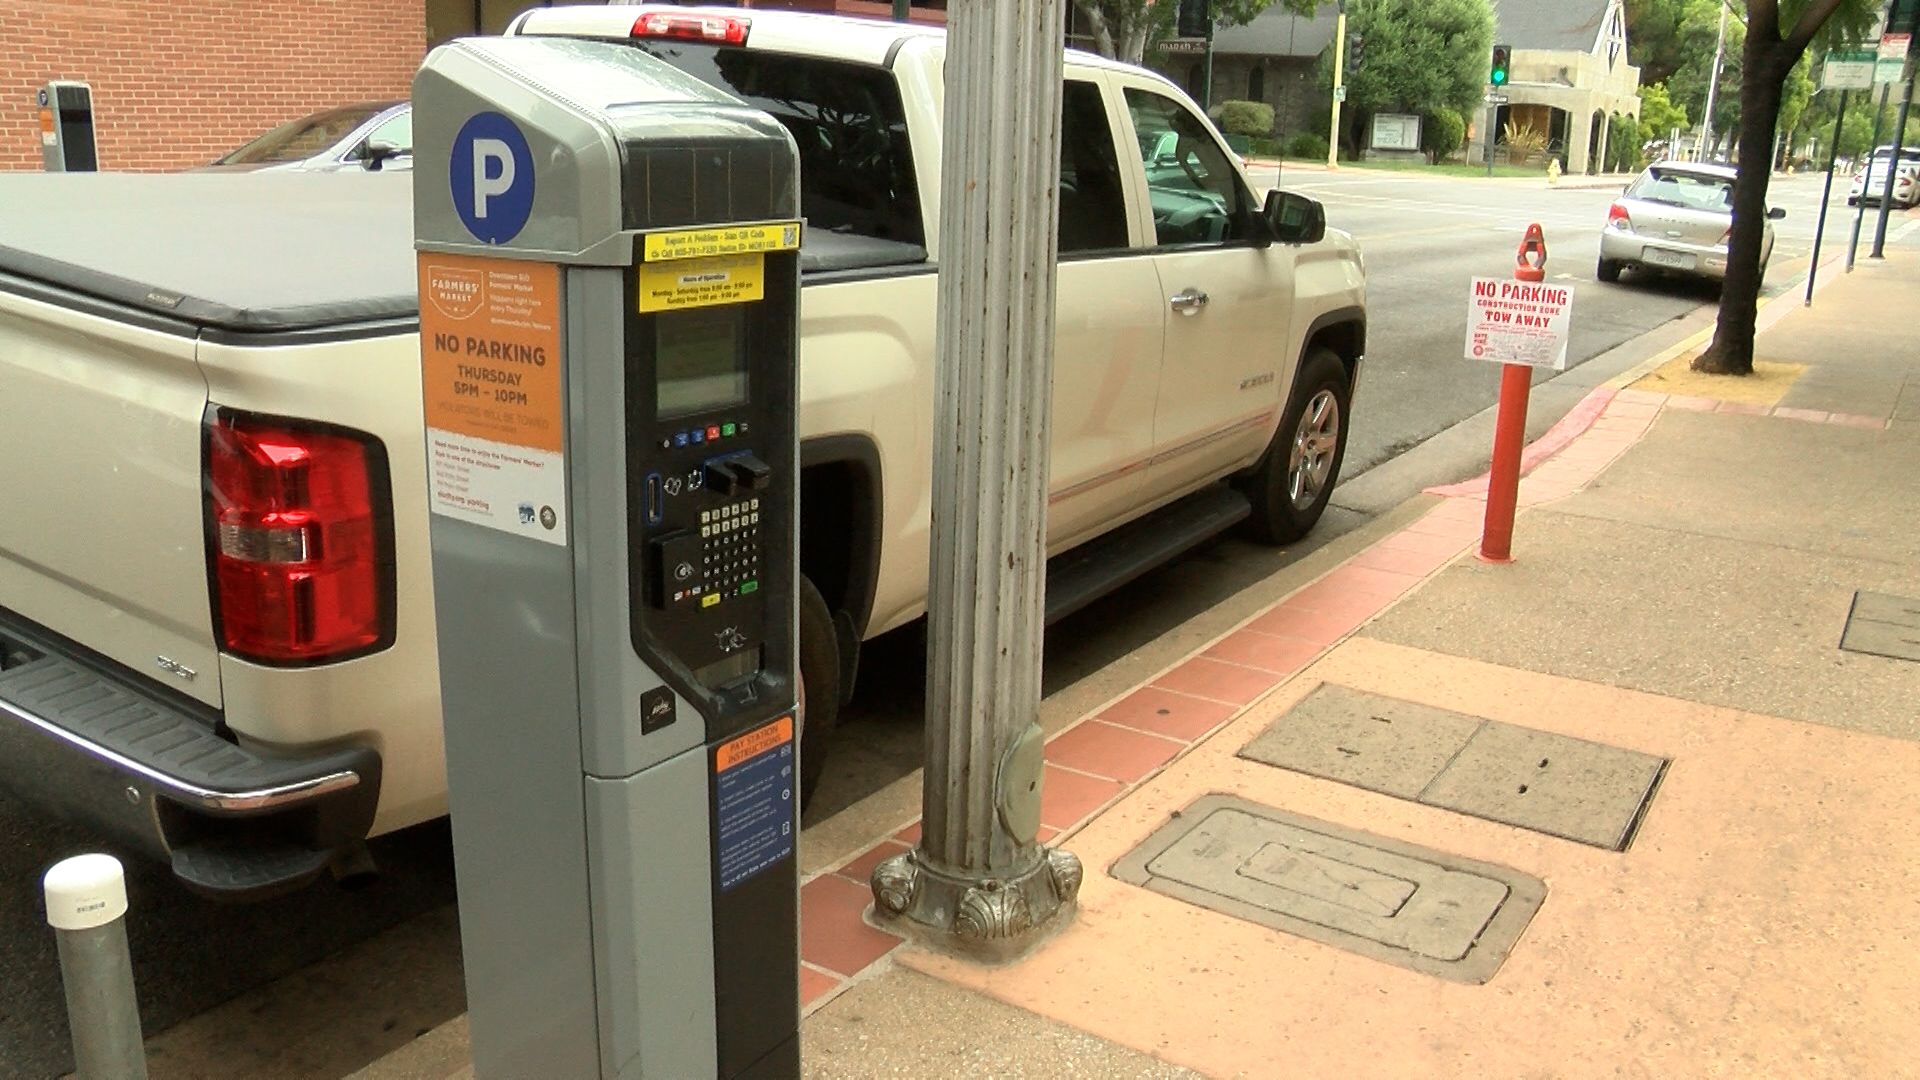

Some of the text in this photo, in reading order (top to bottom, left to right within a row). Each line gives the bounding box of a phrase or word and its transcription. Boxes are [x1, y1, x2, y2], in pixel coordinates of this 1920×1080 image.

[473, 138, 515, 218] P
[665, 237, 686, 246] Report
[694, 233, 719, 243] Problem
[750, 229, 765, 238] Code
[662, 249, 673, 258] Call
[704, 274, 726, 282] Operation
[440, 292, 472, 302] MARKET
[652, 290, 673, 298] Monday
[677, 287, 699, 296] Saturday
[667, 297, 686, 305] Sunday
[1476, 282, 1567, 306] NO PARKING
[1478, 300, 1560, 316] CONSTRUCTION ZONE
[1486, 311, 1551, 328] TOW AWAY
[435, 333, 546, 366] NO PARKING
[457, 364, 522, 386] THURSDAY
[454, 381, 479, 397] 5PM
[495, 391, 527, 405] 10PM
[730, 726, 779, 752] PAY STATION
[728, 735, 782, 764] INSTRUCTIONS
